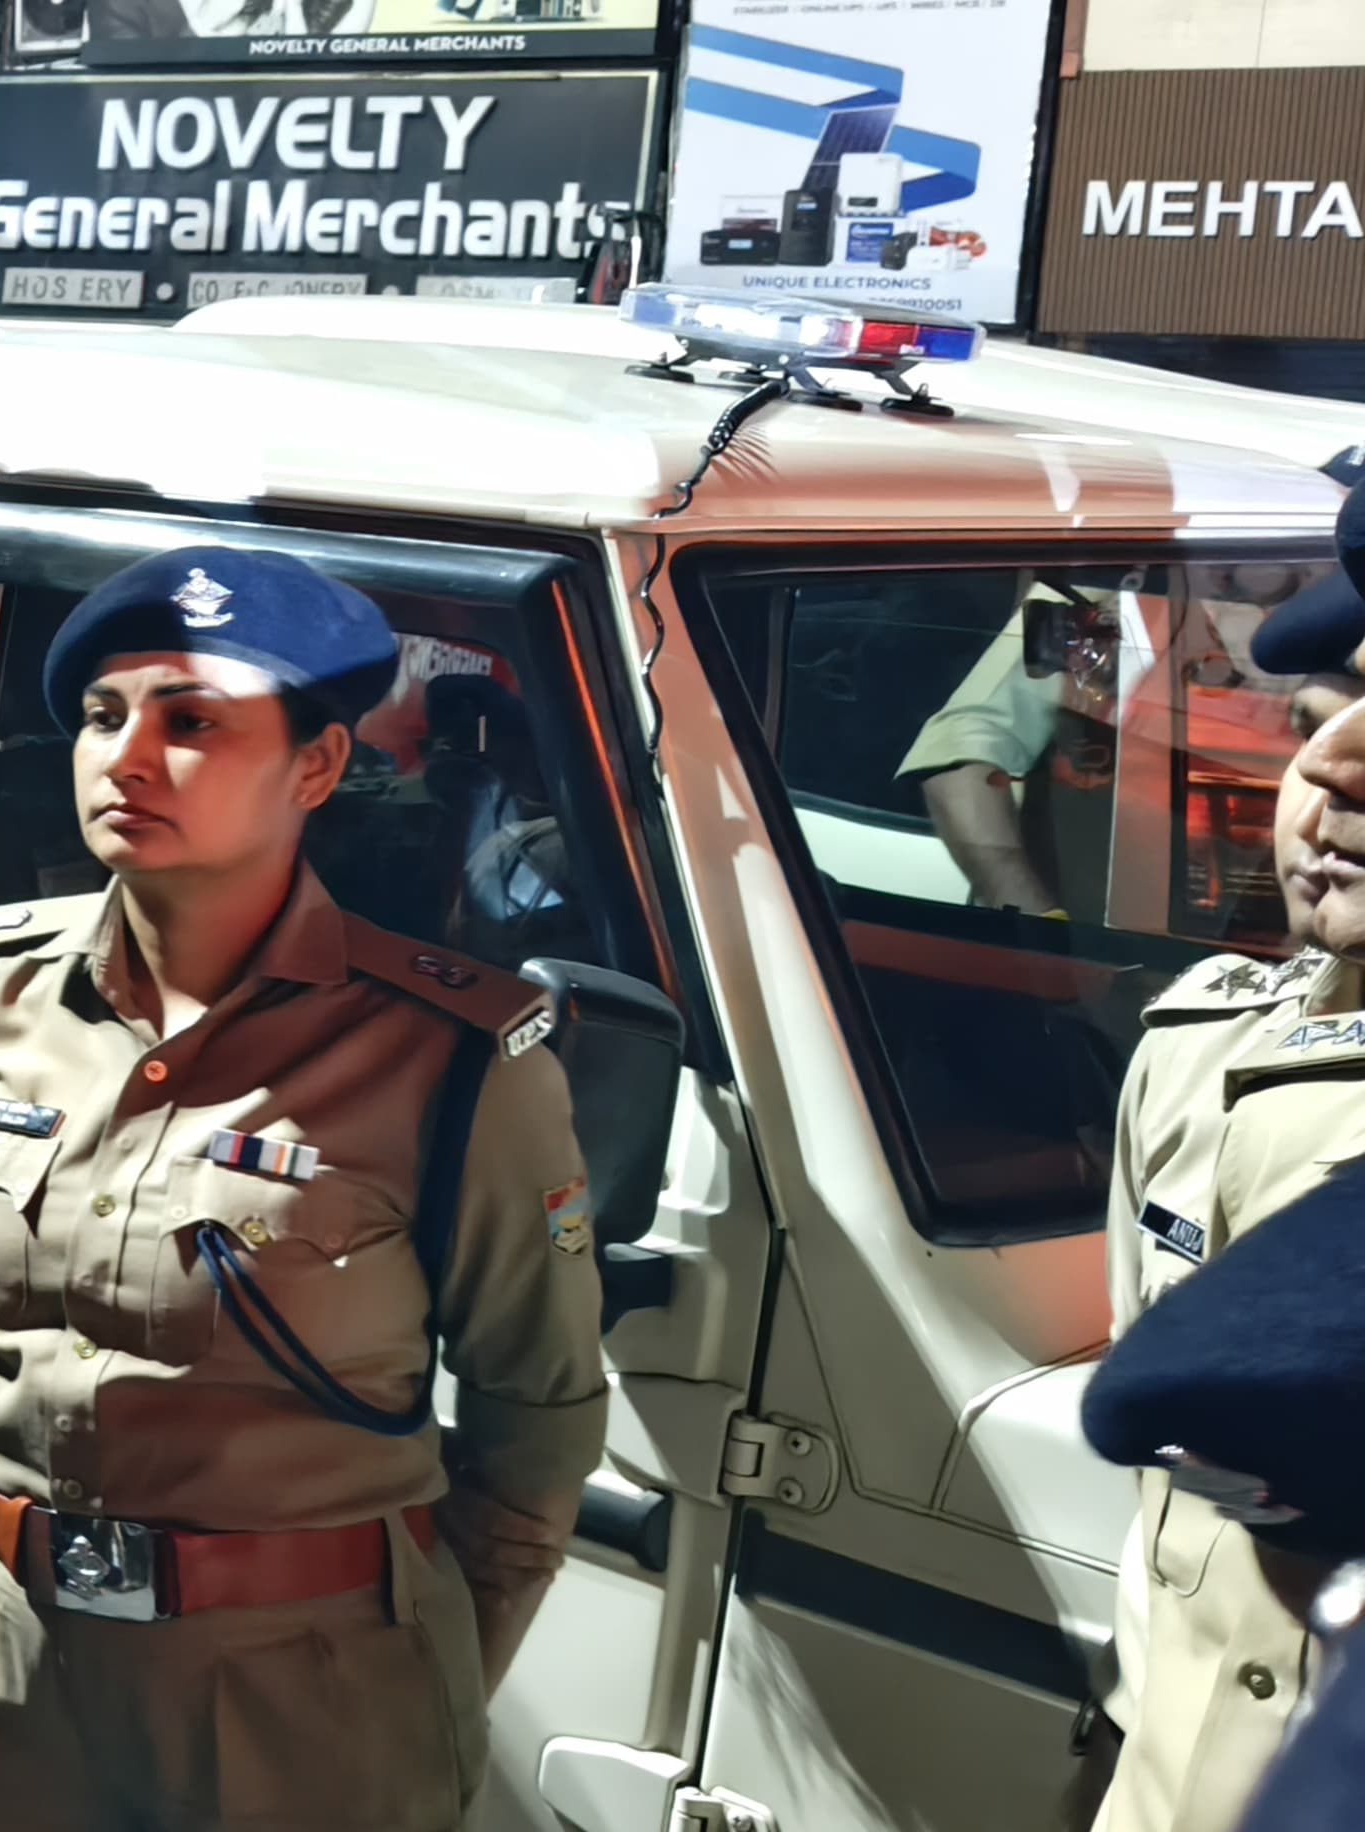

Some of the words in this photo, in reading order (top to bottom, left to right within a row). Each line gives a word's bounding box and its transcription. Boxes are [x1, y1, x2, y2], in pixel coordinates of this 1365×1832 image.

[249, 38, 326, 56] NOVELTY
[329, 36, 411, 54] GENERAL
[413, 34, 526, 52] MERCHANTS
[96, 96, 496, 171] NOVELTY
[1081, 179, 1363, 239] MEHTA
[742, 275, 808, 289] UNIQUE
[812, 277, 932, 291] ELECTRONICS
